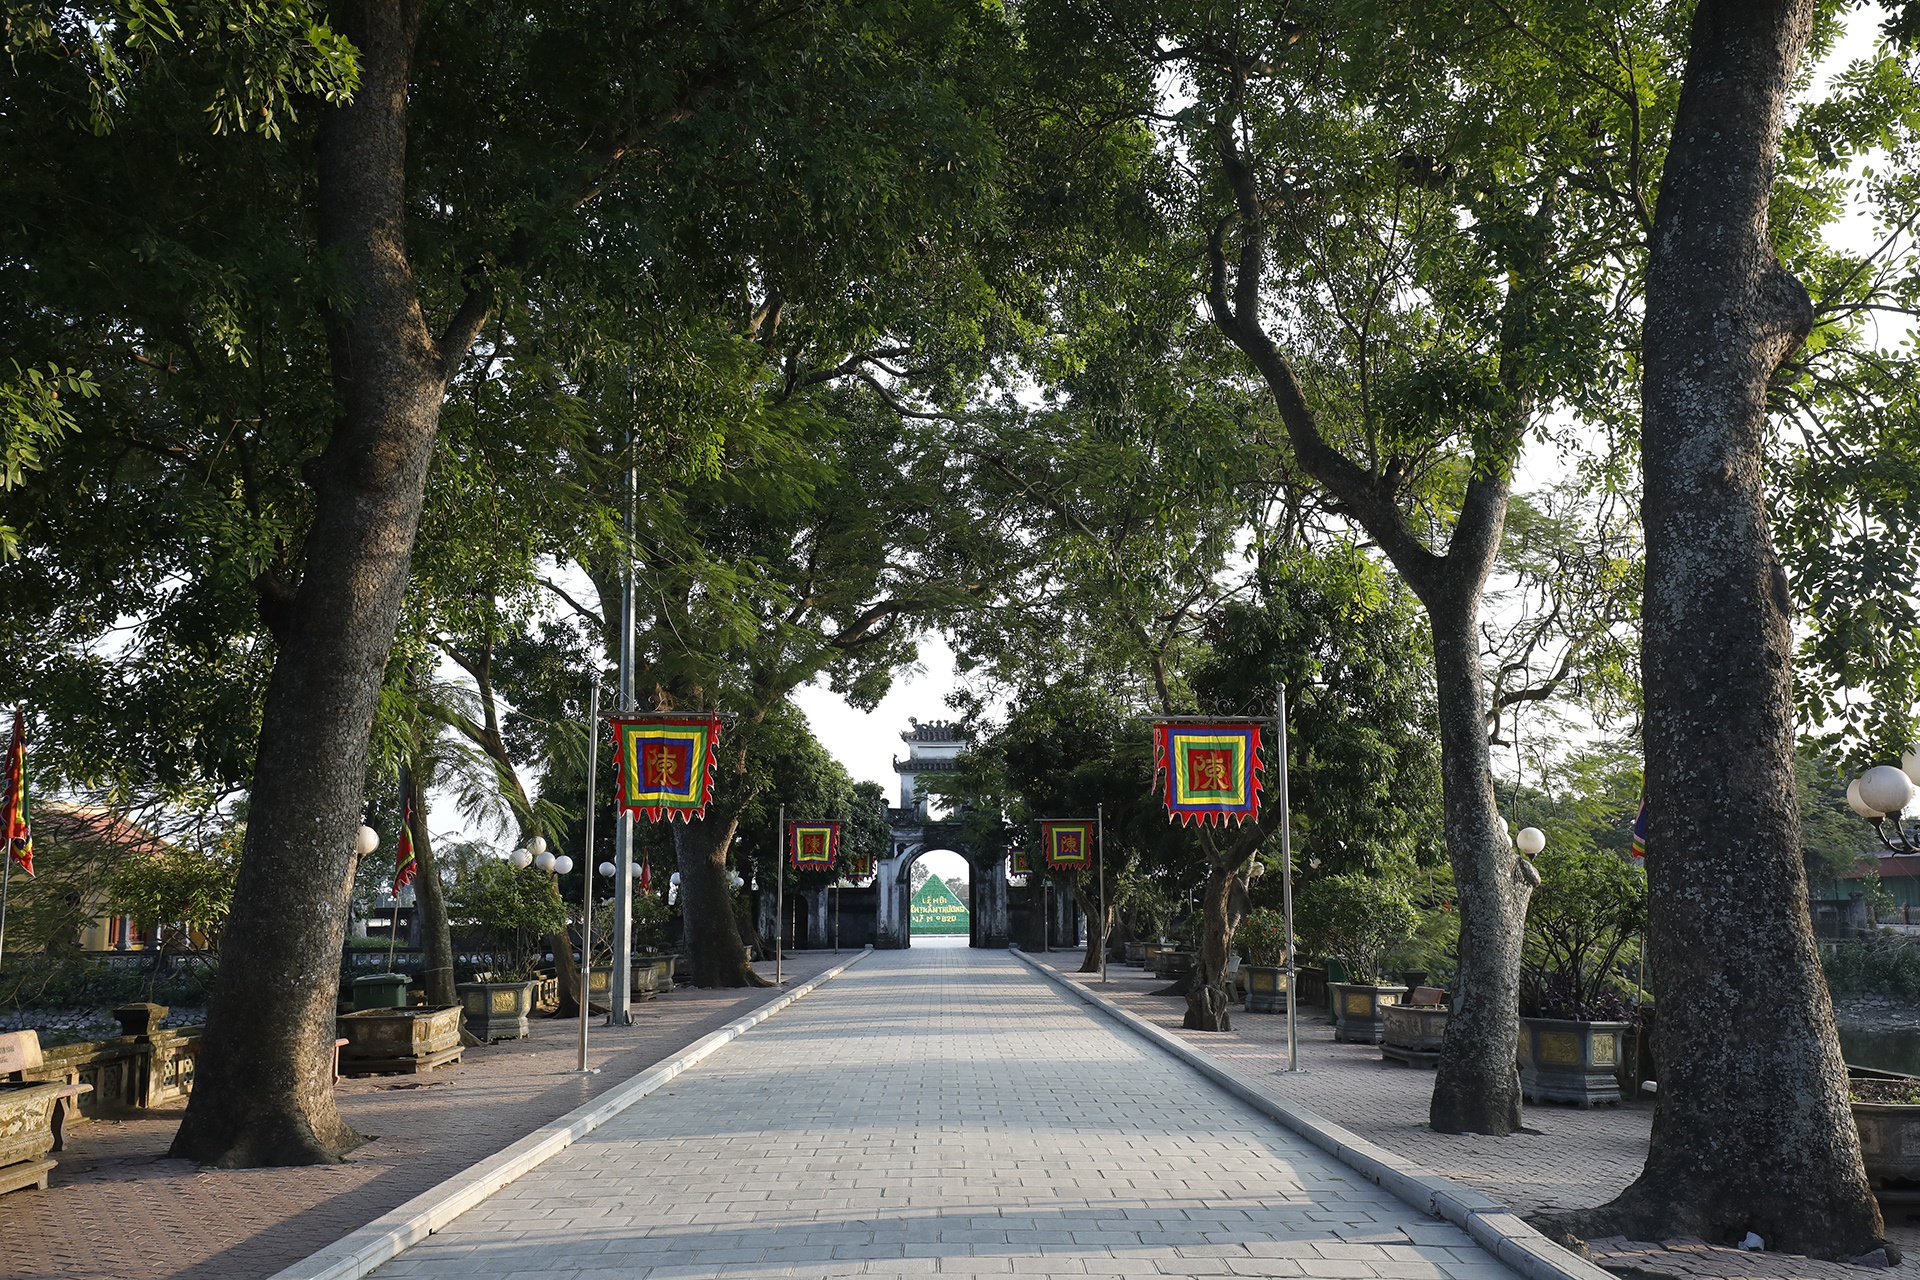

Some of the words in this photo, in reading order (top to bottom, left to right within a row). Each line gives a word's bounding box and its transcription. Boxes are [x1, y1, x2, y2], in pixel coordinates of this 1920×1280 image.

[647, 746, 680, 786] 陳
[1193, 751, 1229, 790] 陳
[1060, 835, 1078, 853] 陳
[932, 895, 947, 906] HỘI
[912, 914, 933, 923] NĂM
